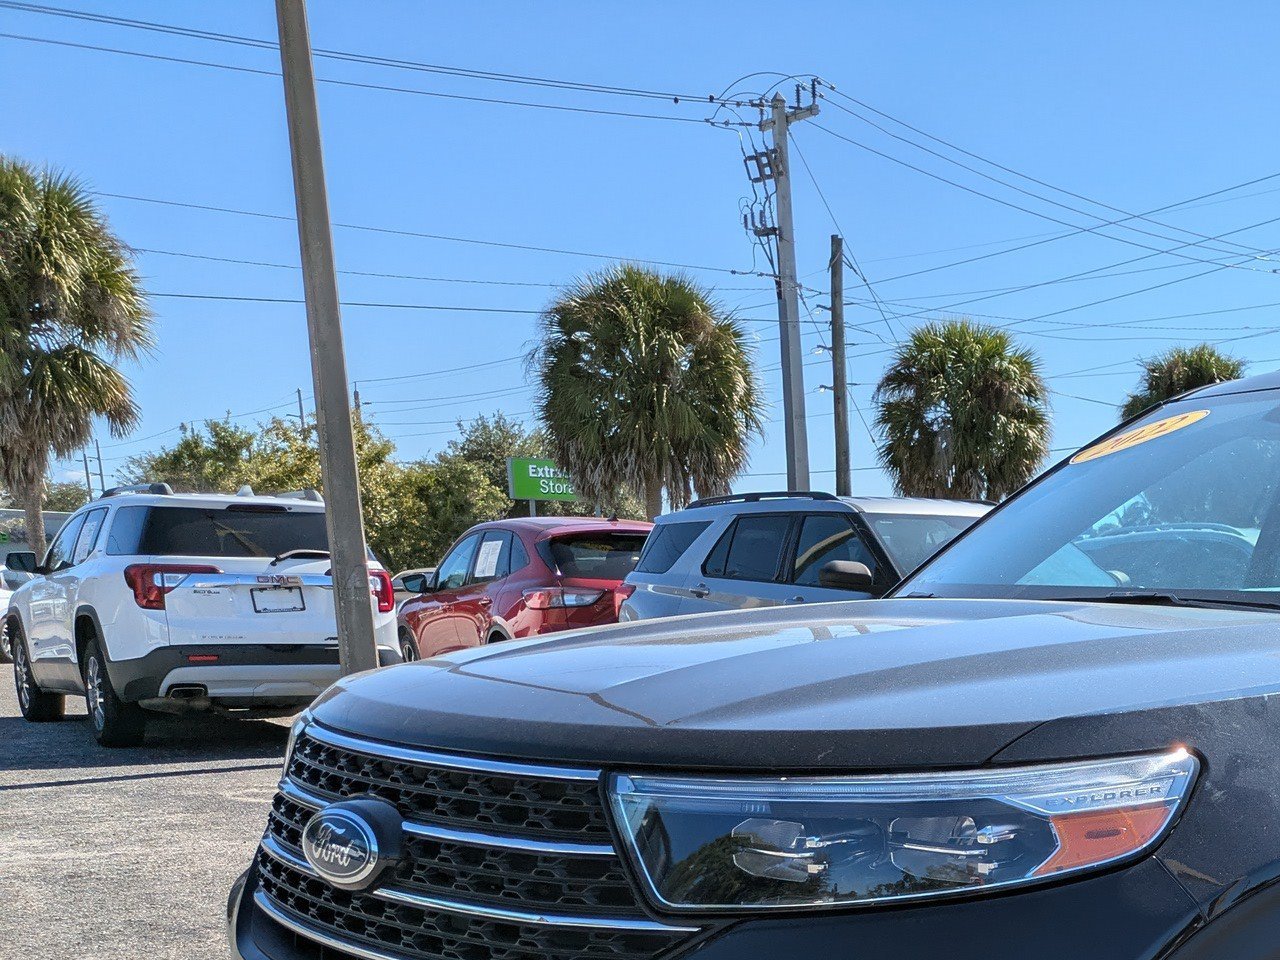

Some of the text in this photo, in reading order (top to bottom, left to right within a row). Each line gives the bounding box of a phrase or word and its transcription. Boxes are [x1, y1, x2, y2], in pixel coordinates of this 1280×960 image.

[539, 479, 575, 494] Stora
[256, 575, 300, 584] GMC
[1045, 786, 1162, 806] EXPLORER
[312, 822, 366, 867] Ford
